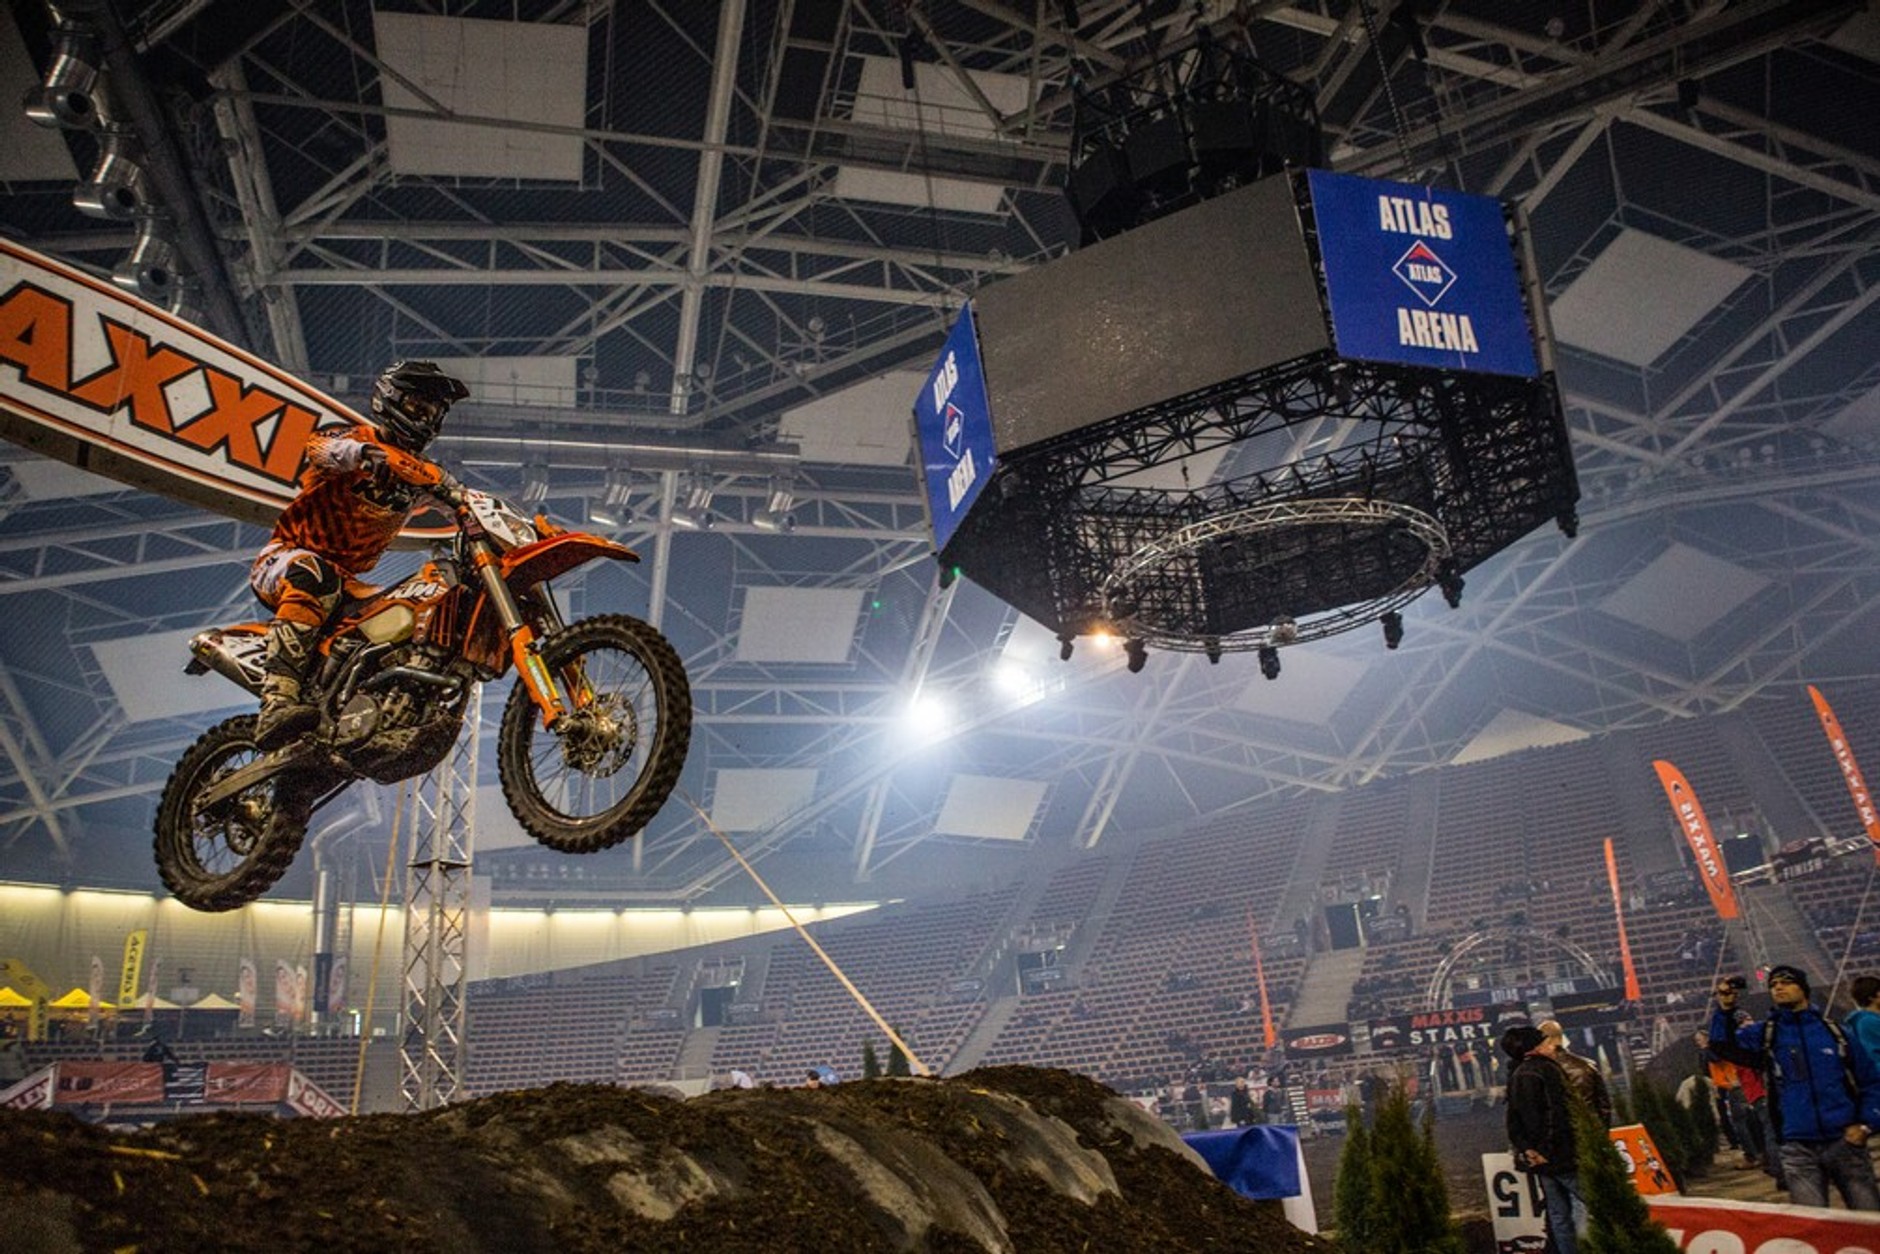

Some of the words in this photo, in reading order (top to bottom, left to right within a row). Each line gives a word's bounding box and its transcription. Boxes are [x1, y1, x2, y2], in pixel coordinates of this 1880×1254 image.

[1379, 194, 1453, 241] ATLAS
[1406, 261, 1443, 285] ATLAS
[1397, 307, 1479, 353] ARENA
[1410, 1007, 1485, 1029] MAXXIS
[1409, 1022, 1493, 1045] START
